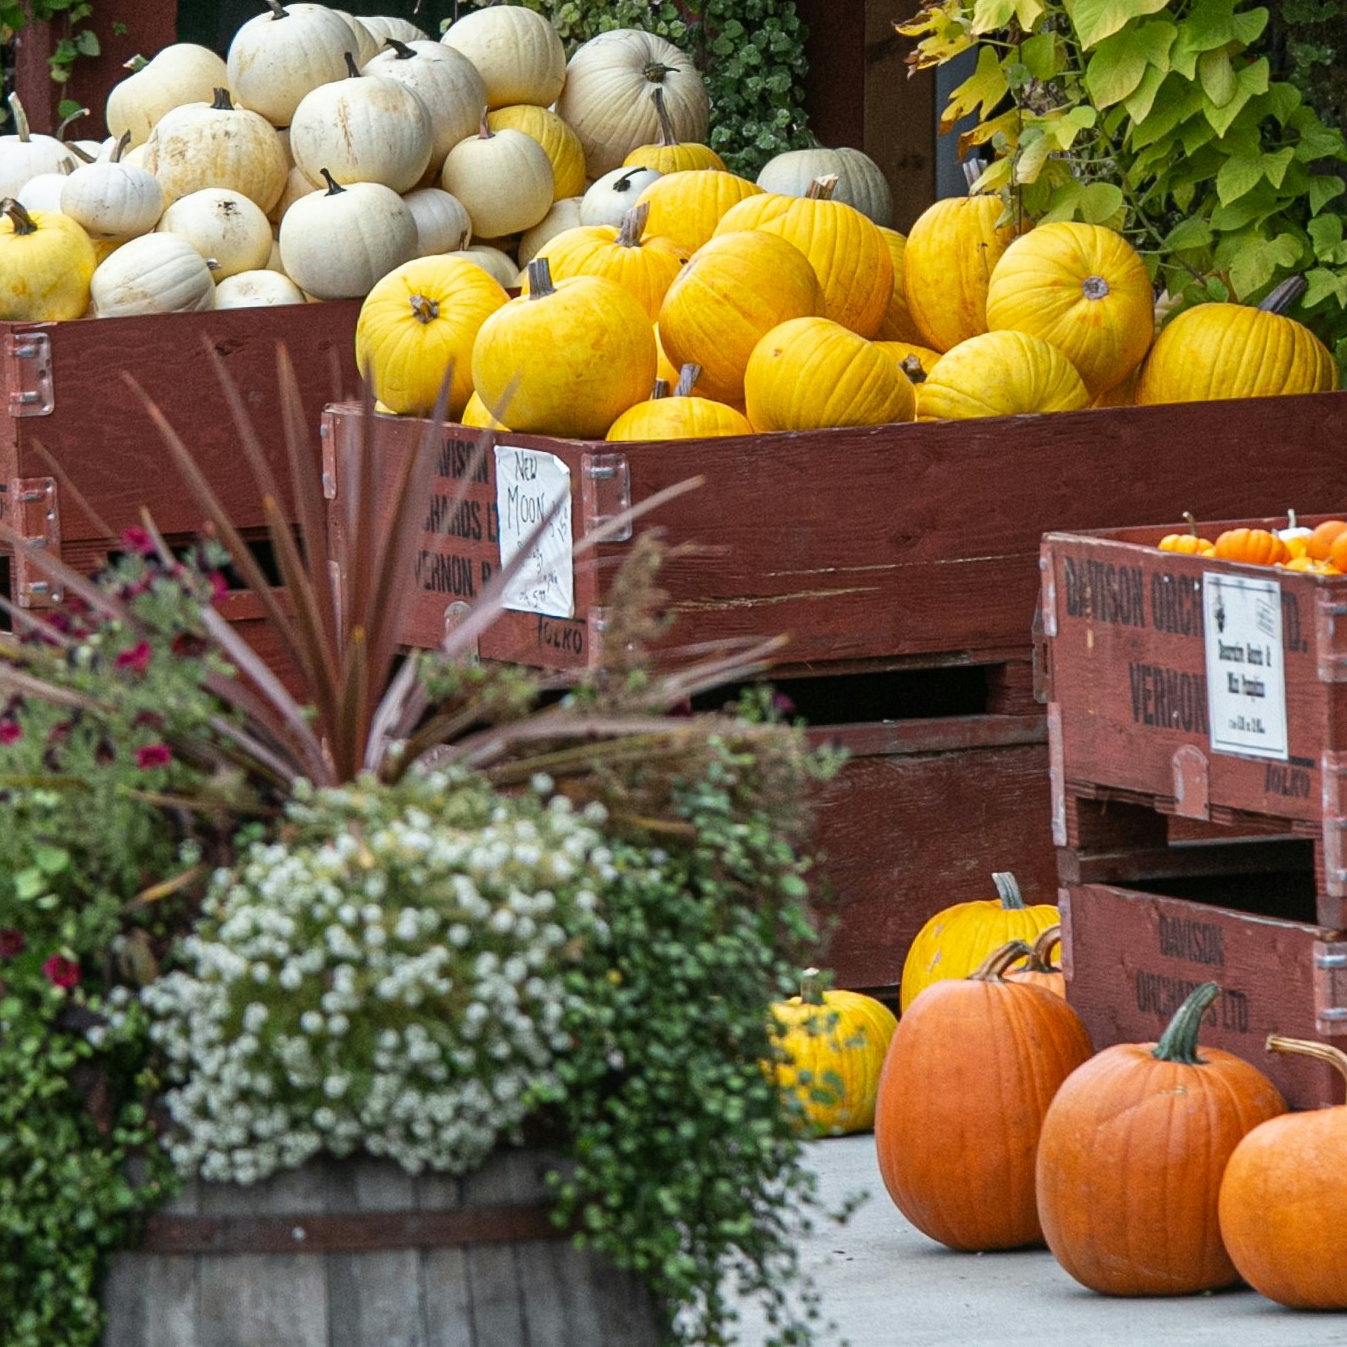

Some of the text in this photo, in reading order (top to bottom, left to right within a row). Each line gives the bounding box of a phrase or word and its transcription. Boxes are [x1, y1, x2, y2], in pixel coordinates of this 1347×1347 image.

[1063, 556, 1146, 627] DAVISON
[1159, 915, 1224, 966] DAVISON
[1222, 989, 1249, 1034] LTD
